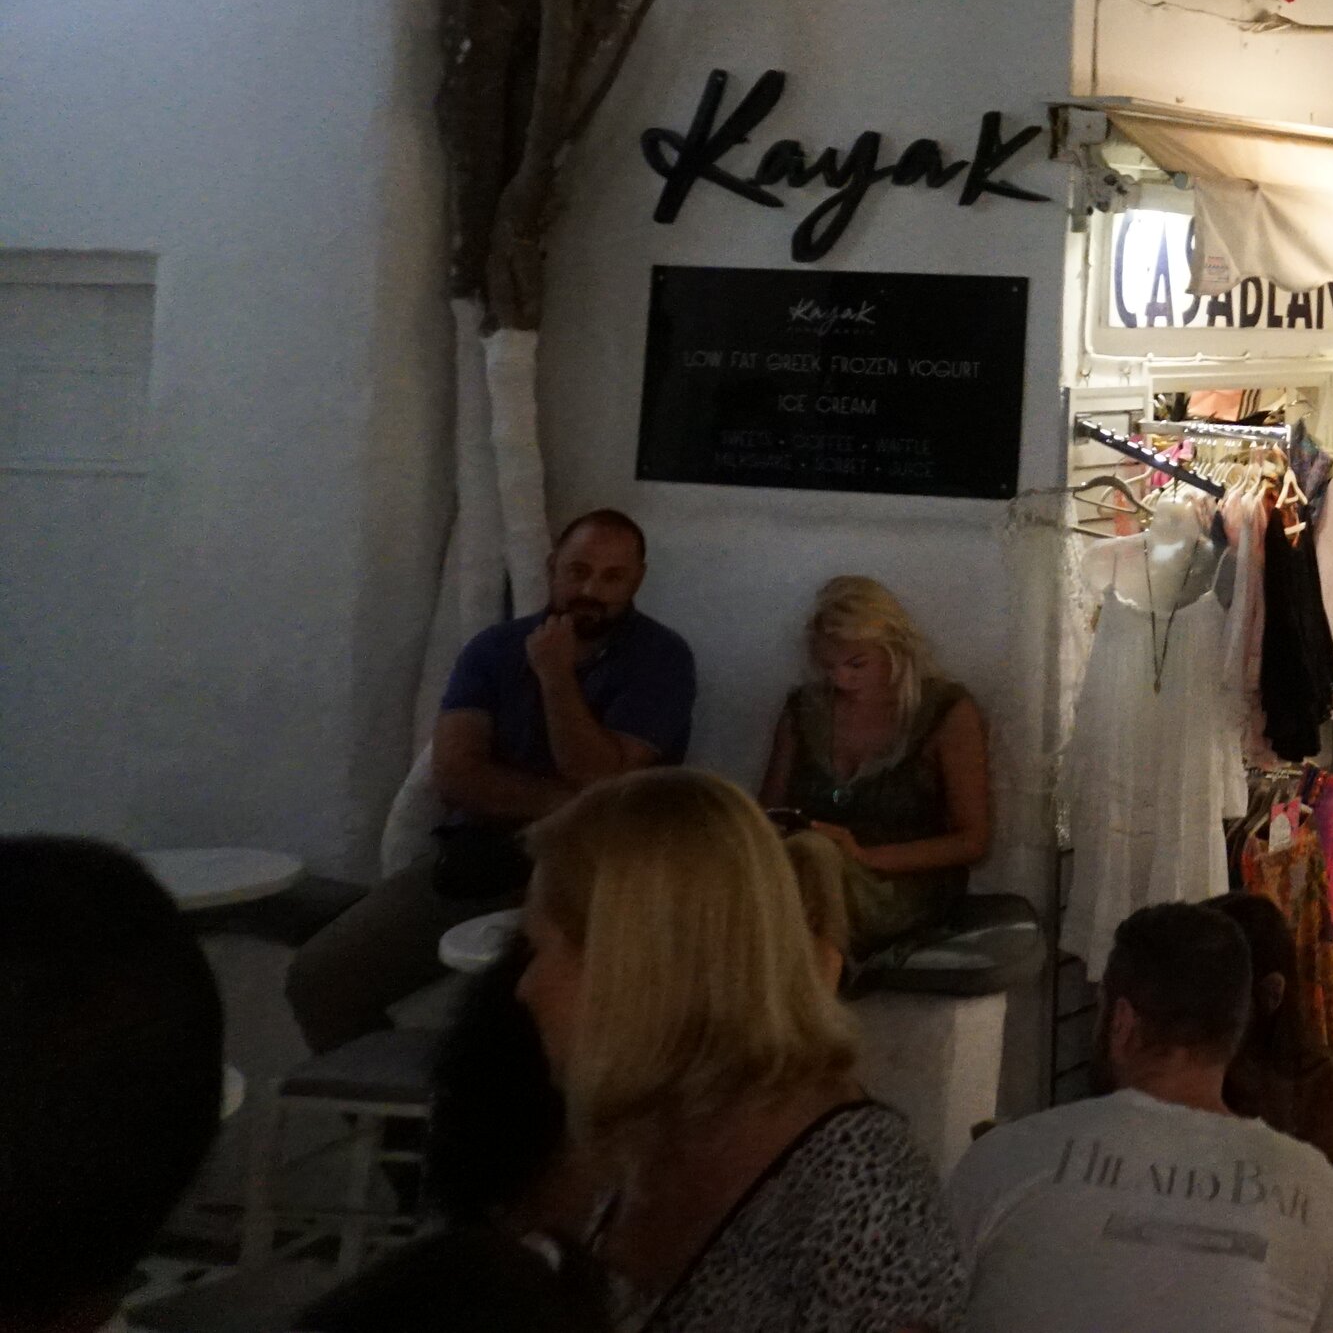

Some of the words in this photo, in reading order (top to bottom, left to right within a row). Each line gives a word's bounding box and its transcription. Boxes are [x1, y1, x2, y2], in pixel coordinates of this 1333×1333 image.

[683, 351, 727, 369] LOW
[731, 353, 758, 370] FAT
[766, 354, 821, 373] GREEK
[830, 356, 898, 375] FROZEN
[907, 358, 982, 378] YOGURT
[777, 395, 805, 413] ICE
[815, 397, 878, 415] CREAM
